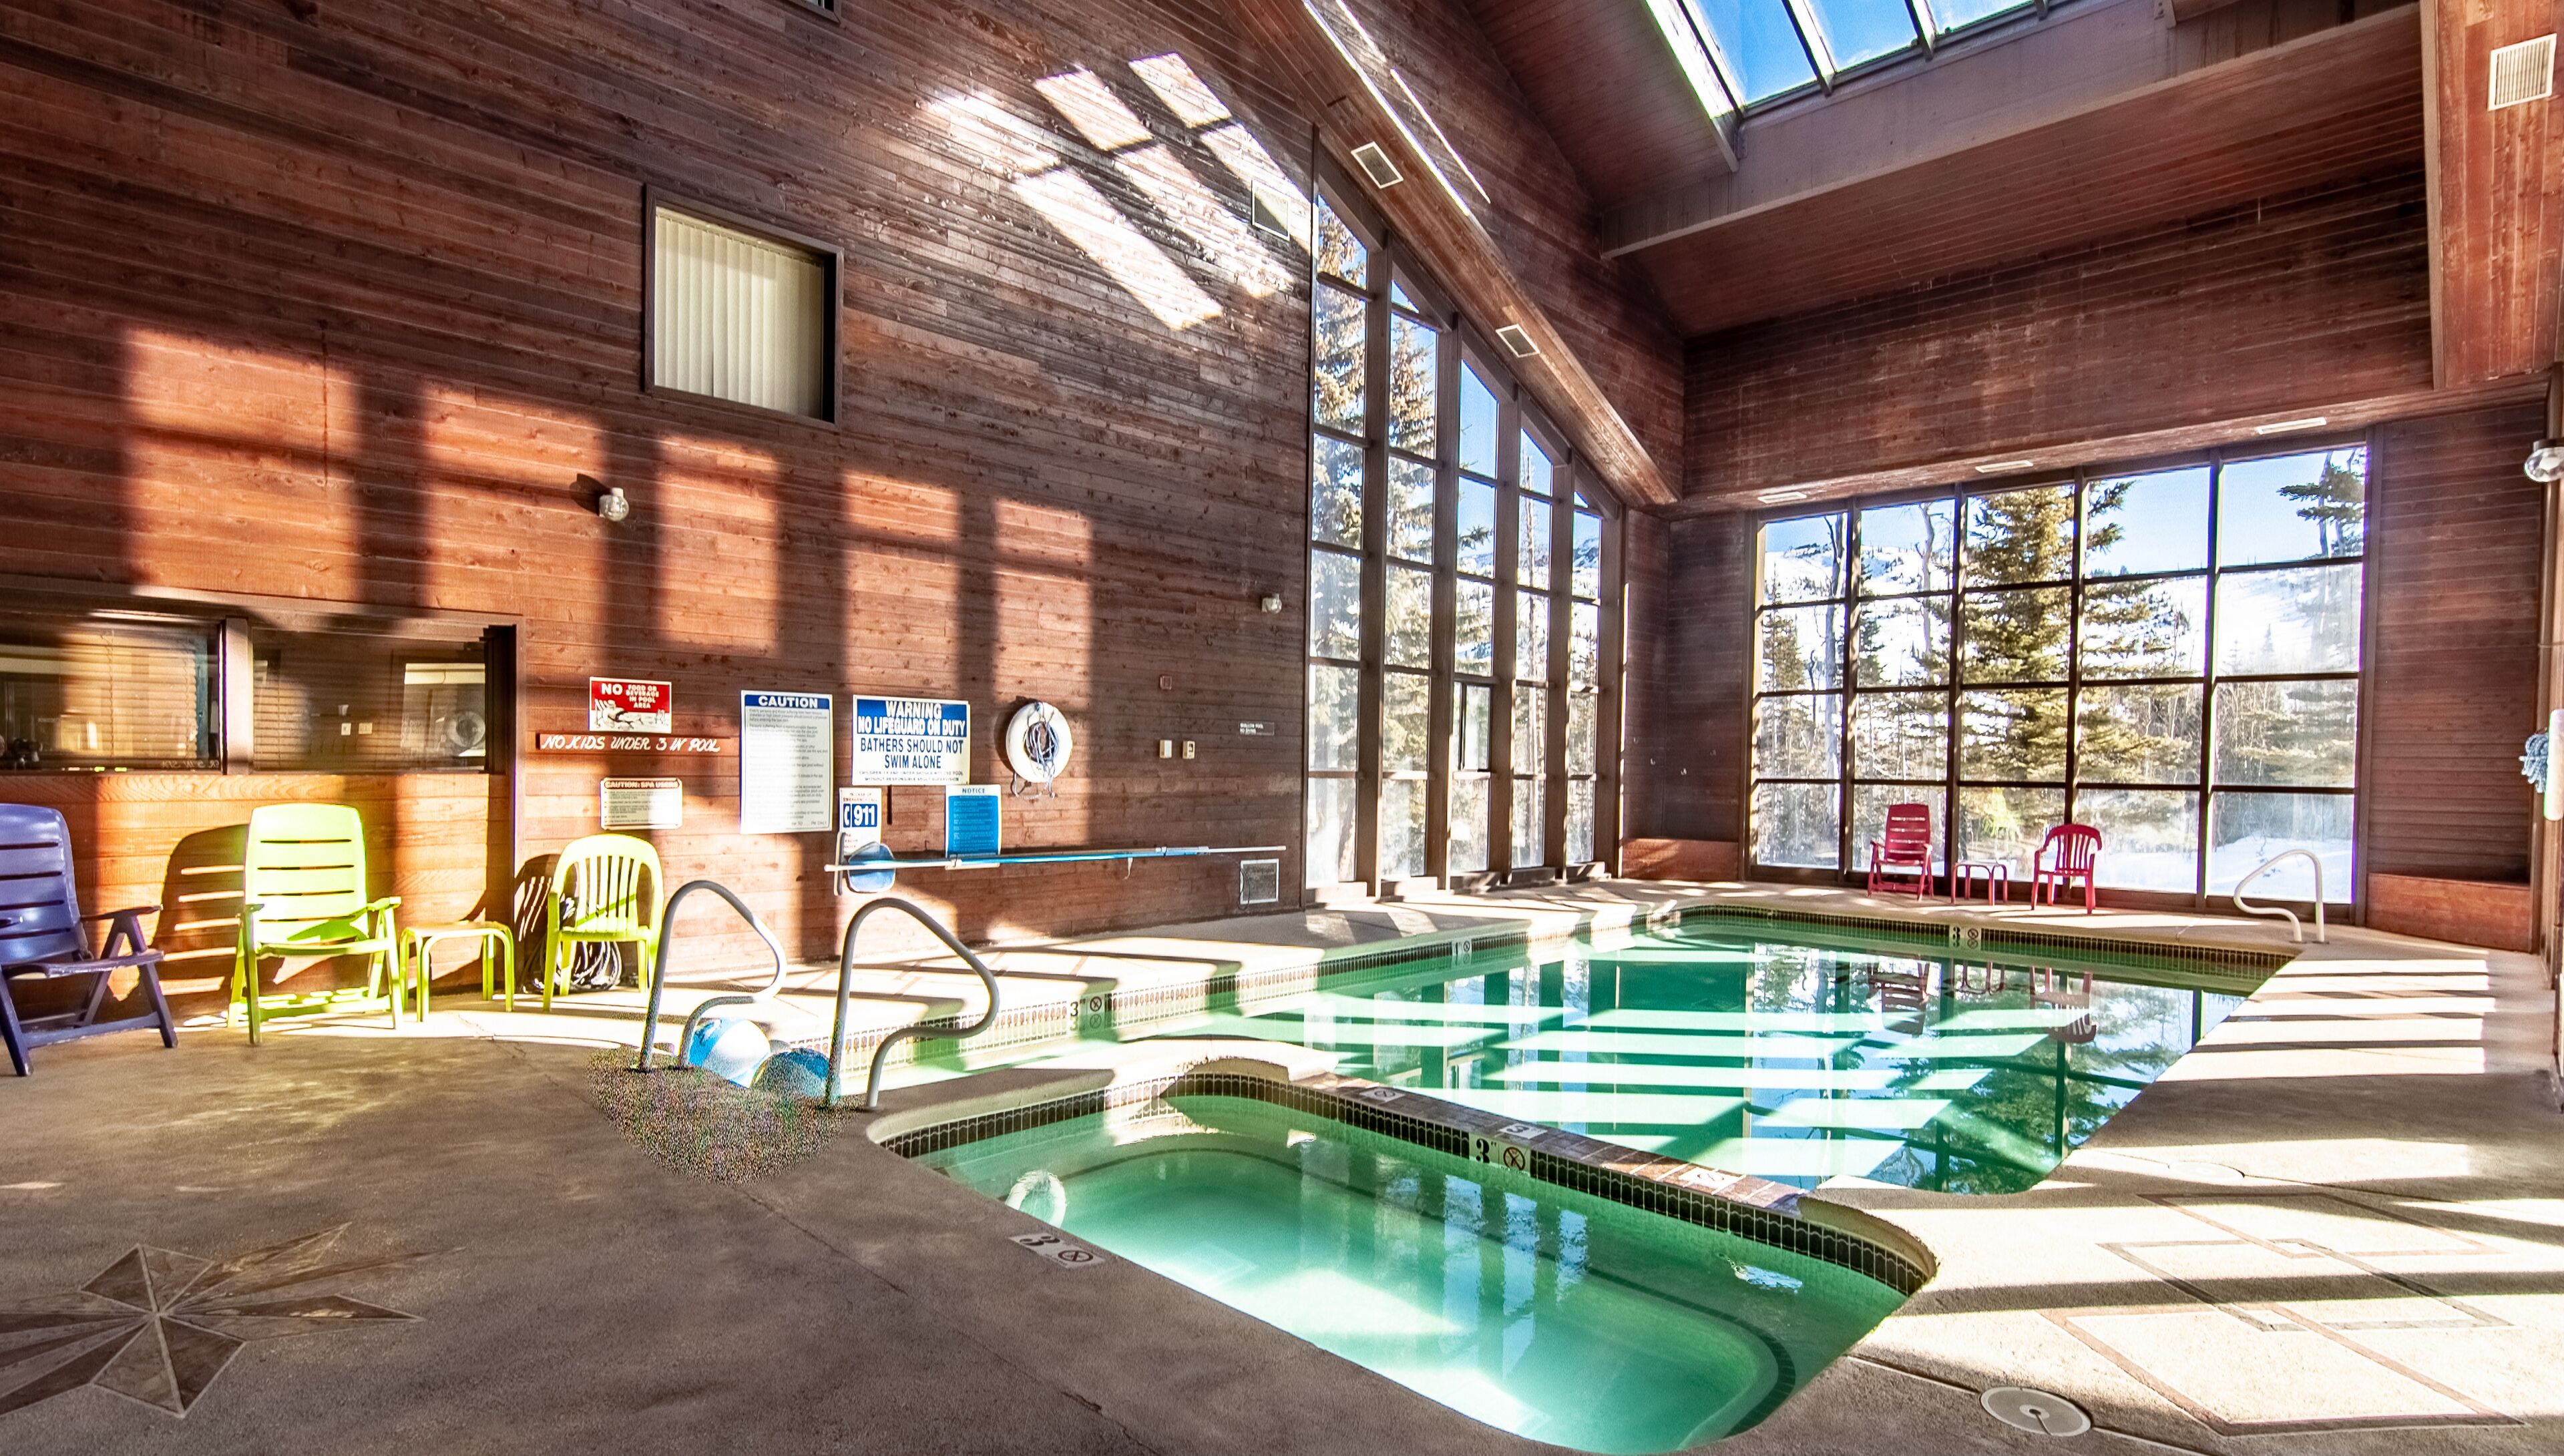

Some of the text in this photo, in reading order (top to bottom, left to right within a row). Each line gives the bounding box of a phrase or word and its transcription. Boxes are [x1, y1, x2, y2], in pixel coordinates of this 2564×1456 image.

[601, 683, 623, 695] NO
[626, 690, 659, 698] BEVERAGE
[758, 696, 818, 708] CAUTION
[885, 700, 942, 719] WARNING
[858, 716, 965, 736] NO LIFEGUARD ON DUTY
[542, 734, 720, 752] NO KIDS UNDER 3 IN POOL
[861, 738, 964, 754] BATHERS SHOULD NOT
[885, 754, 941, 768] SWIM ALONE
[853, 805, 875, 826] 911
